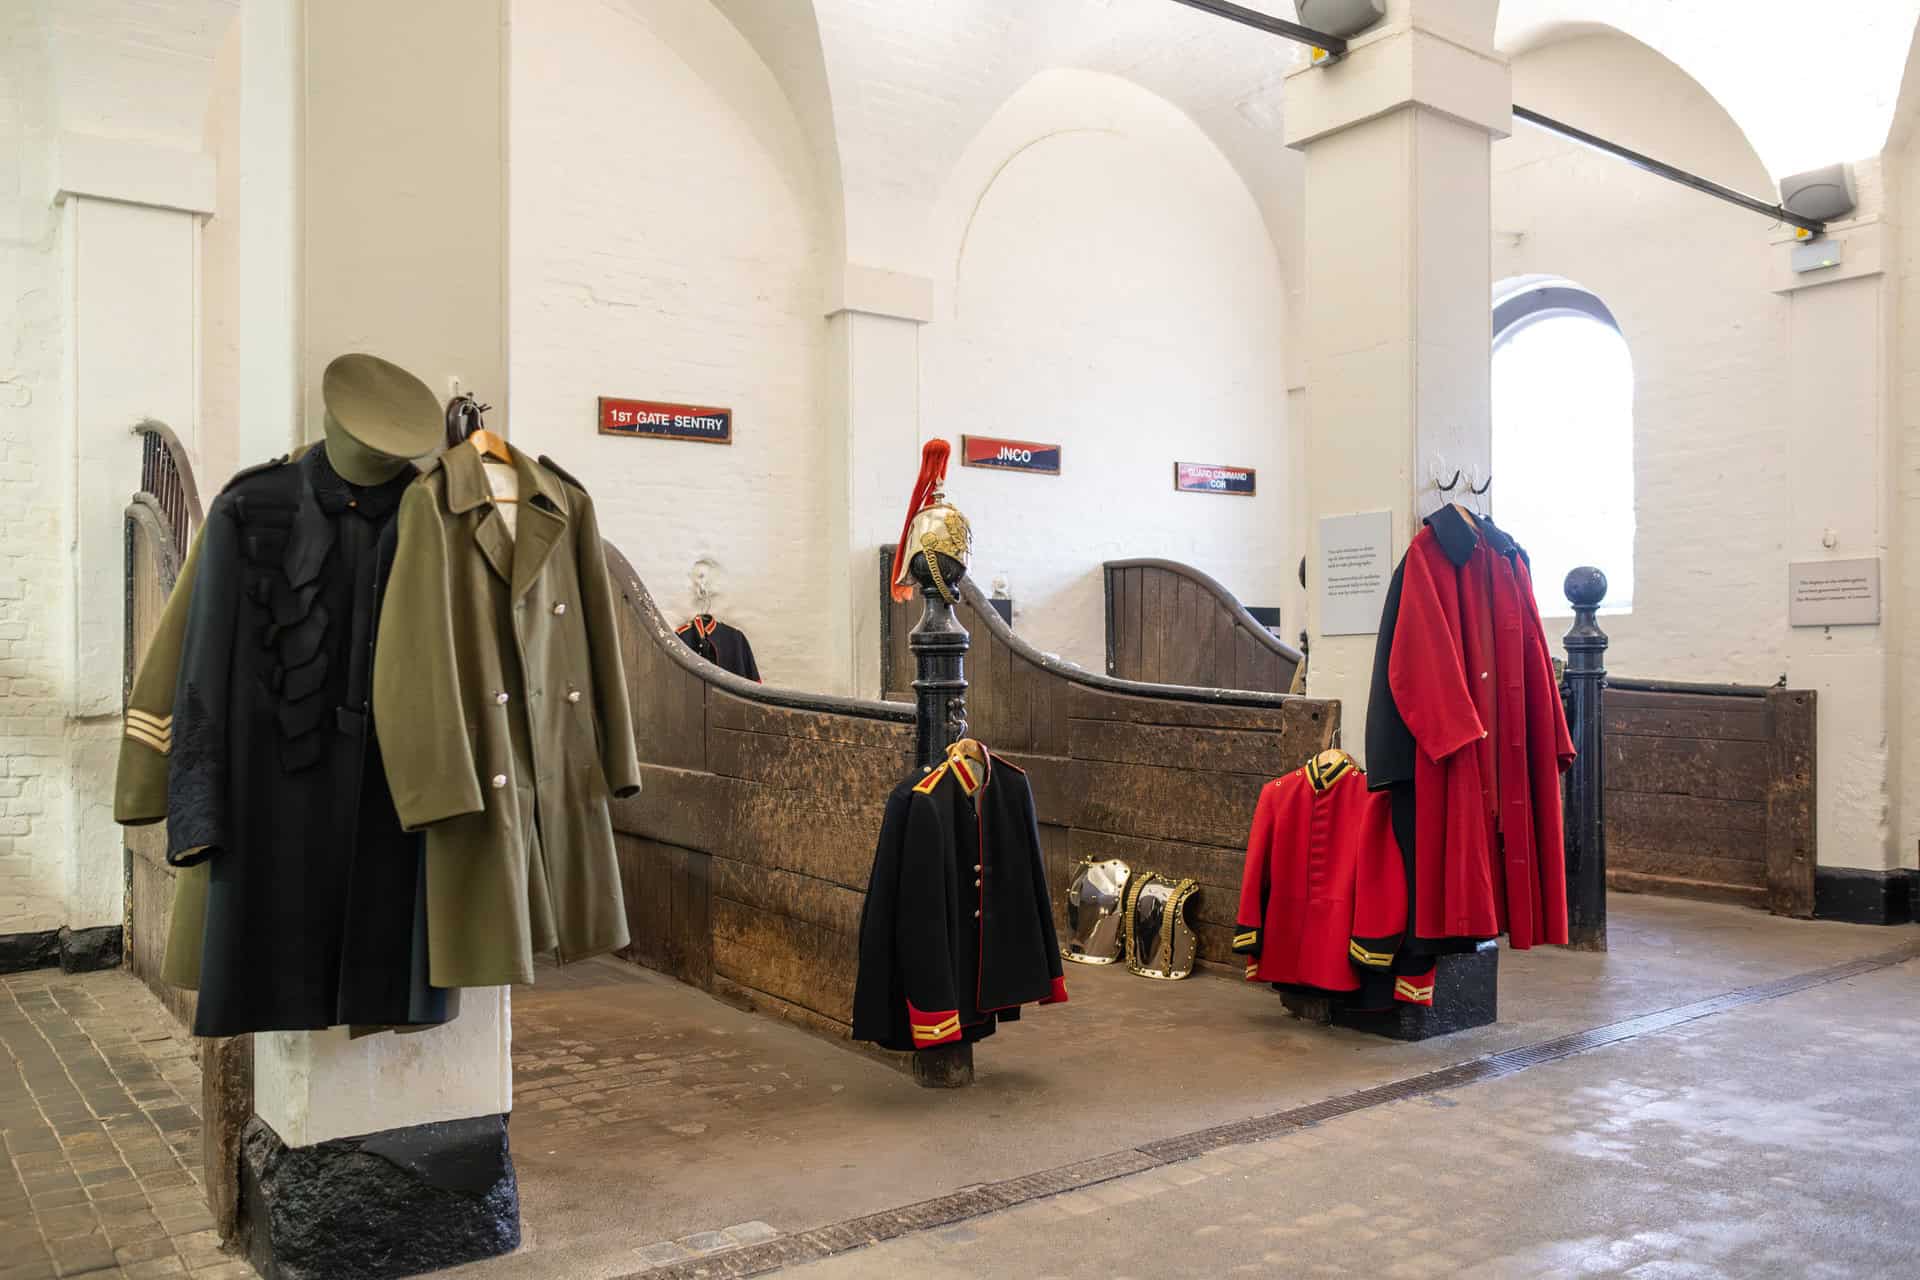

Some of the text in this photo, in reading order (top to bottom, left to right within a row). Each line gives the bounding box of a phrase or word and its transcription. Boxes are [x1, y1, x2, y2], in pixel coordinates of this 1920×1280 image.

[610, 409, 723, 431] 1ST GATE SENTRY
[996, 446, 1032, 462] JNCO
